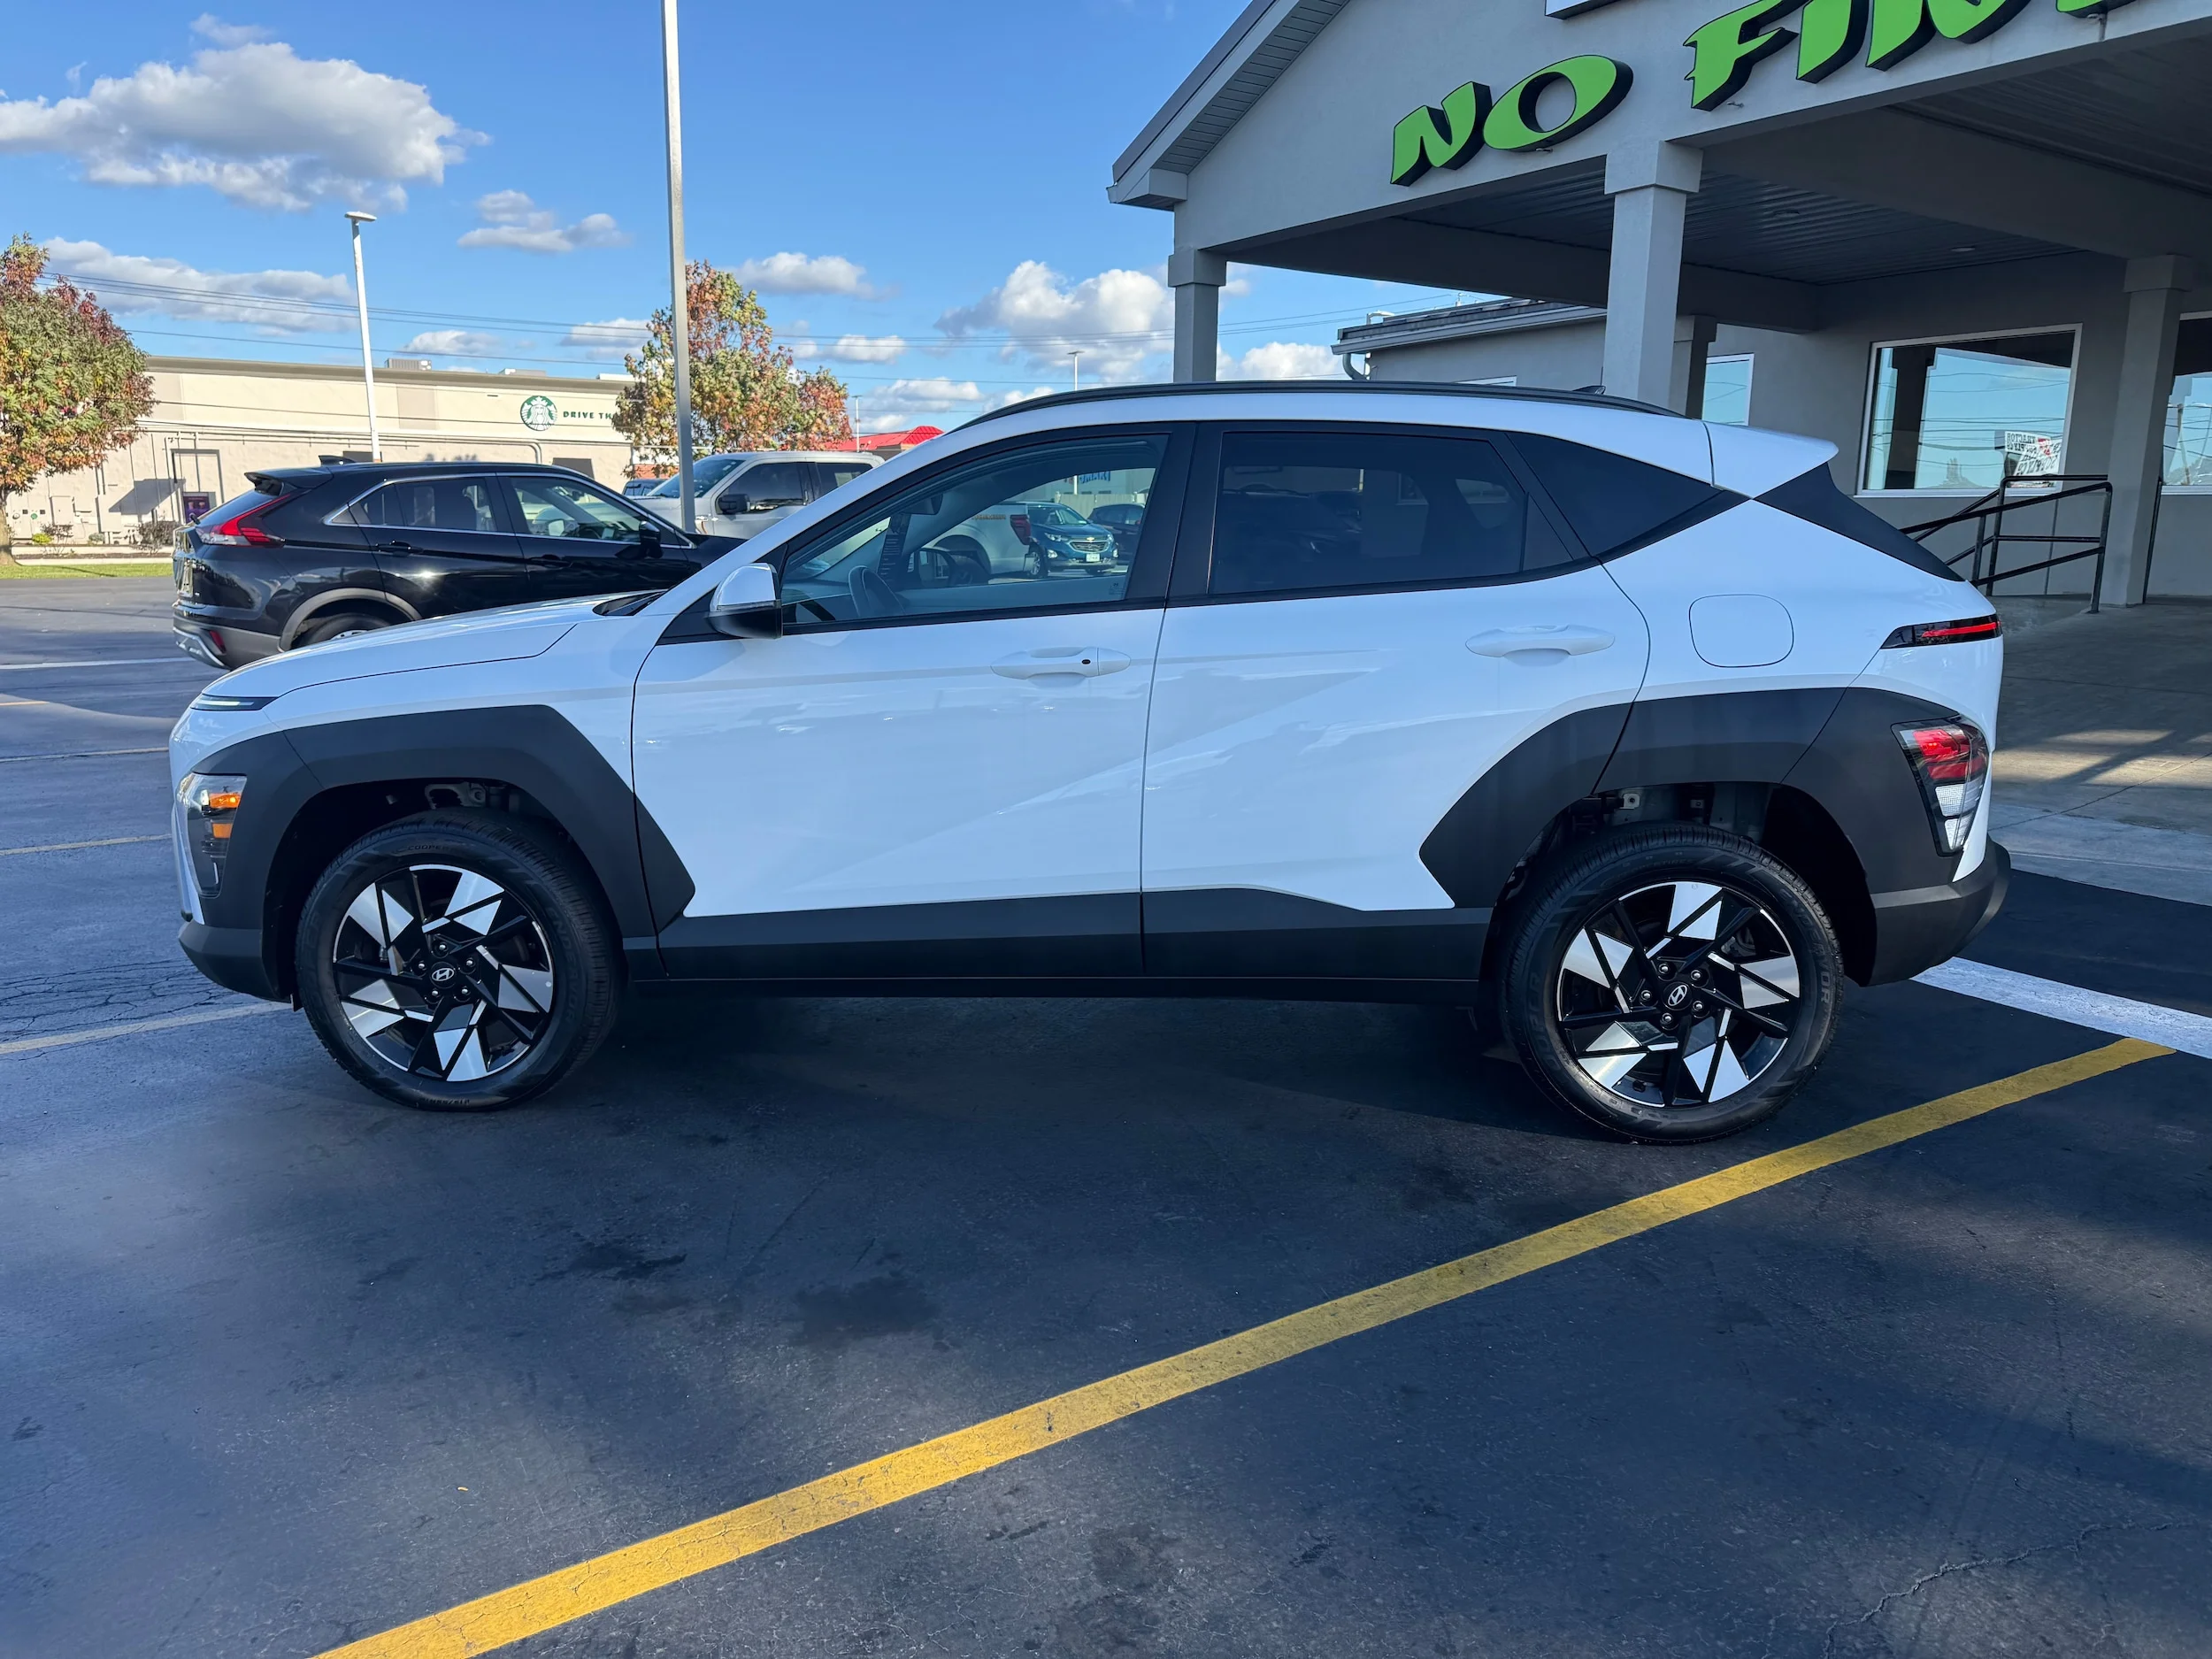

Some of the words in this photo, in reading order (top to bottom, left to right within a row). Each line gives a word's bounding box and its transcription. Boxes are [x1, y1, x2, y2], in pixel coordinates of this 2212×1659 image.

[1390, 54, 1633, 187] NO
[1683, 0, 2138, 111] FIN
[563, 411, 595, 419] DRIVE
